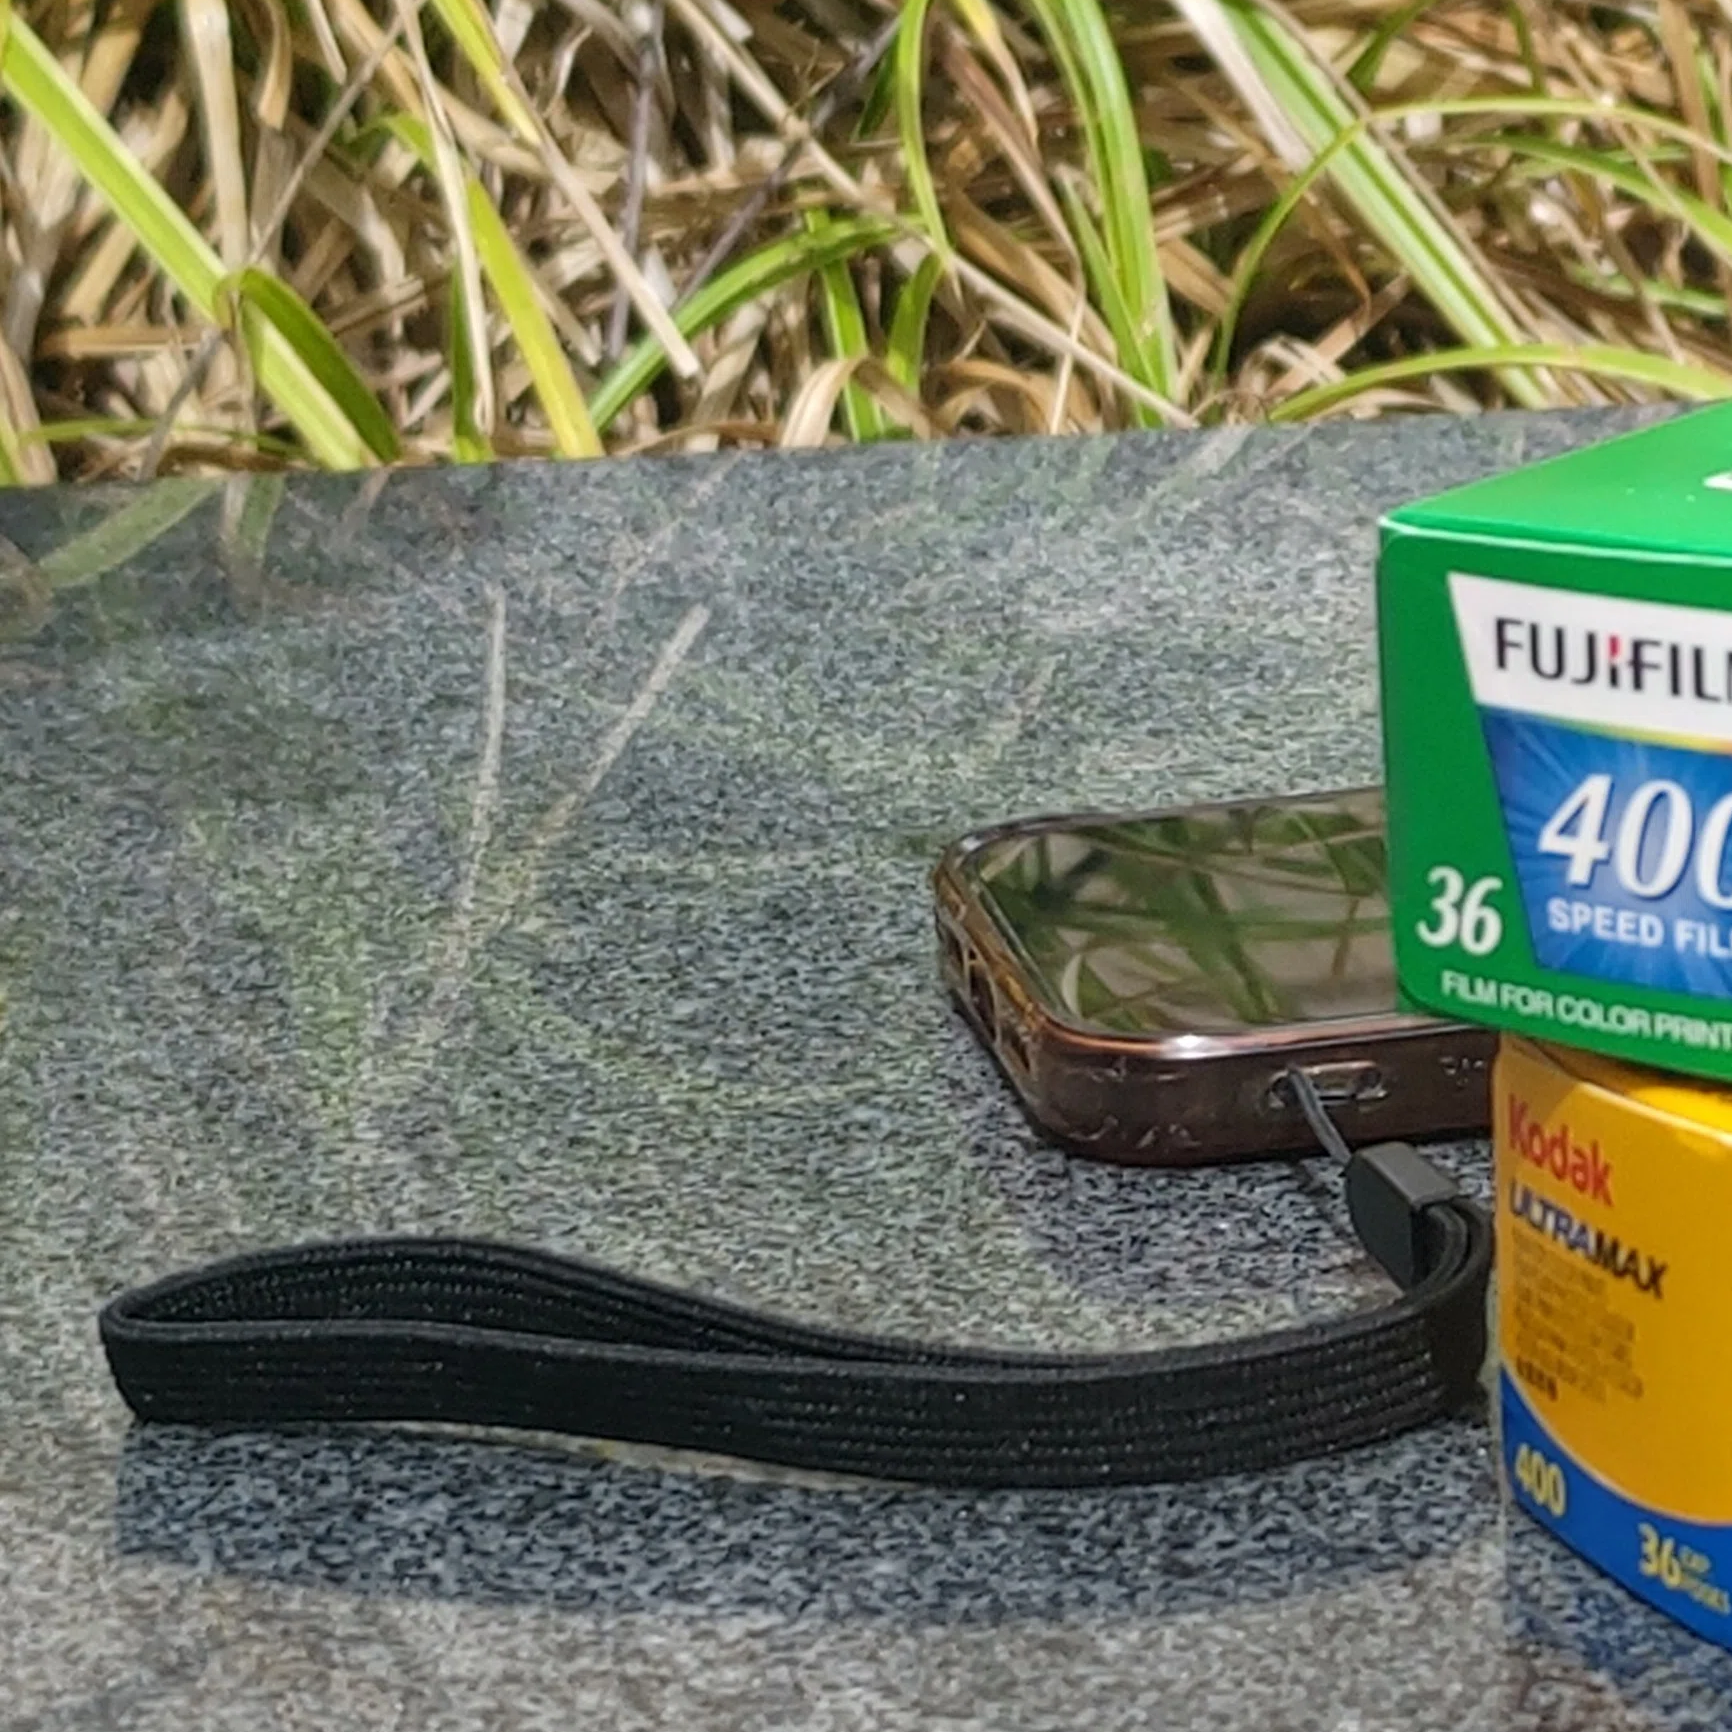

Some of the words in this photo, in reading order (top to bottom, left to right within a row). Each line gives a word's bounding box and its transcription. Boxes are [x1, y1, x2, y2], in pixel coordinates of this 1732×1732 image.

[1415, 865, 1504, 957] 36
[1546, 897, 1665, 949] SPEED
[1441, 969, 1499, 1007] FILM
[1500, 983, 1555, 1020] FOR
[1556, 994, 1652, 1034] COLOR
[1508, 1092, 1615, 1209] Kodak
[1510, 1178, 1669, 1301] ULTRAMAX
[1515, 1443, 1566, 1517] 400
[1639, 1522, 1681, 1589] 36
